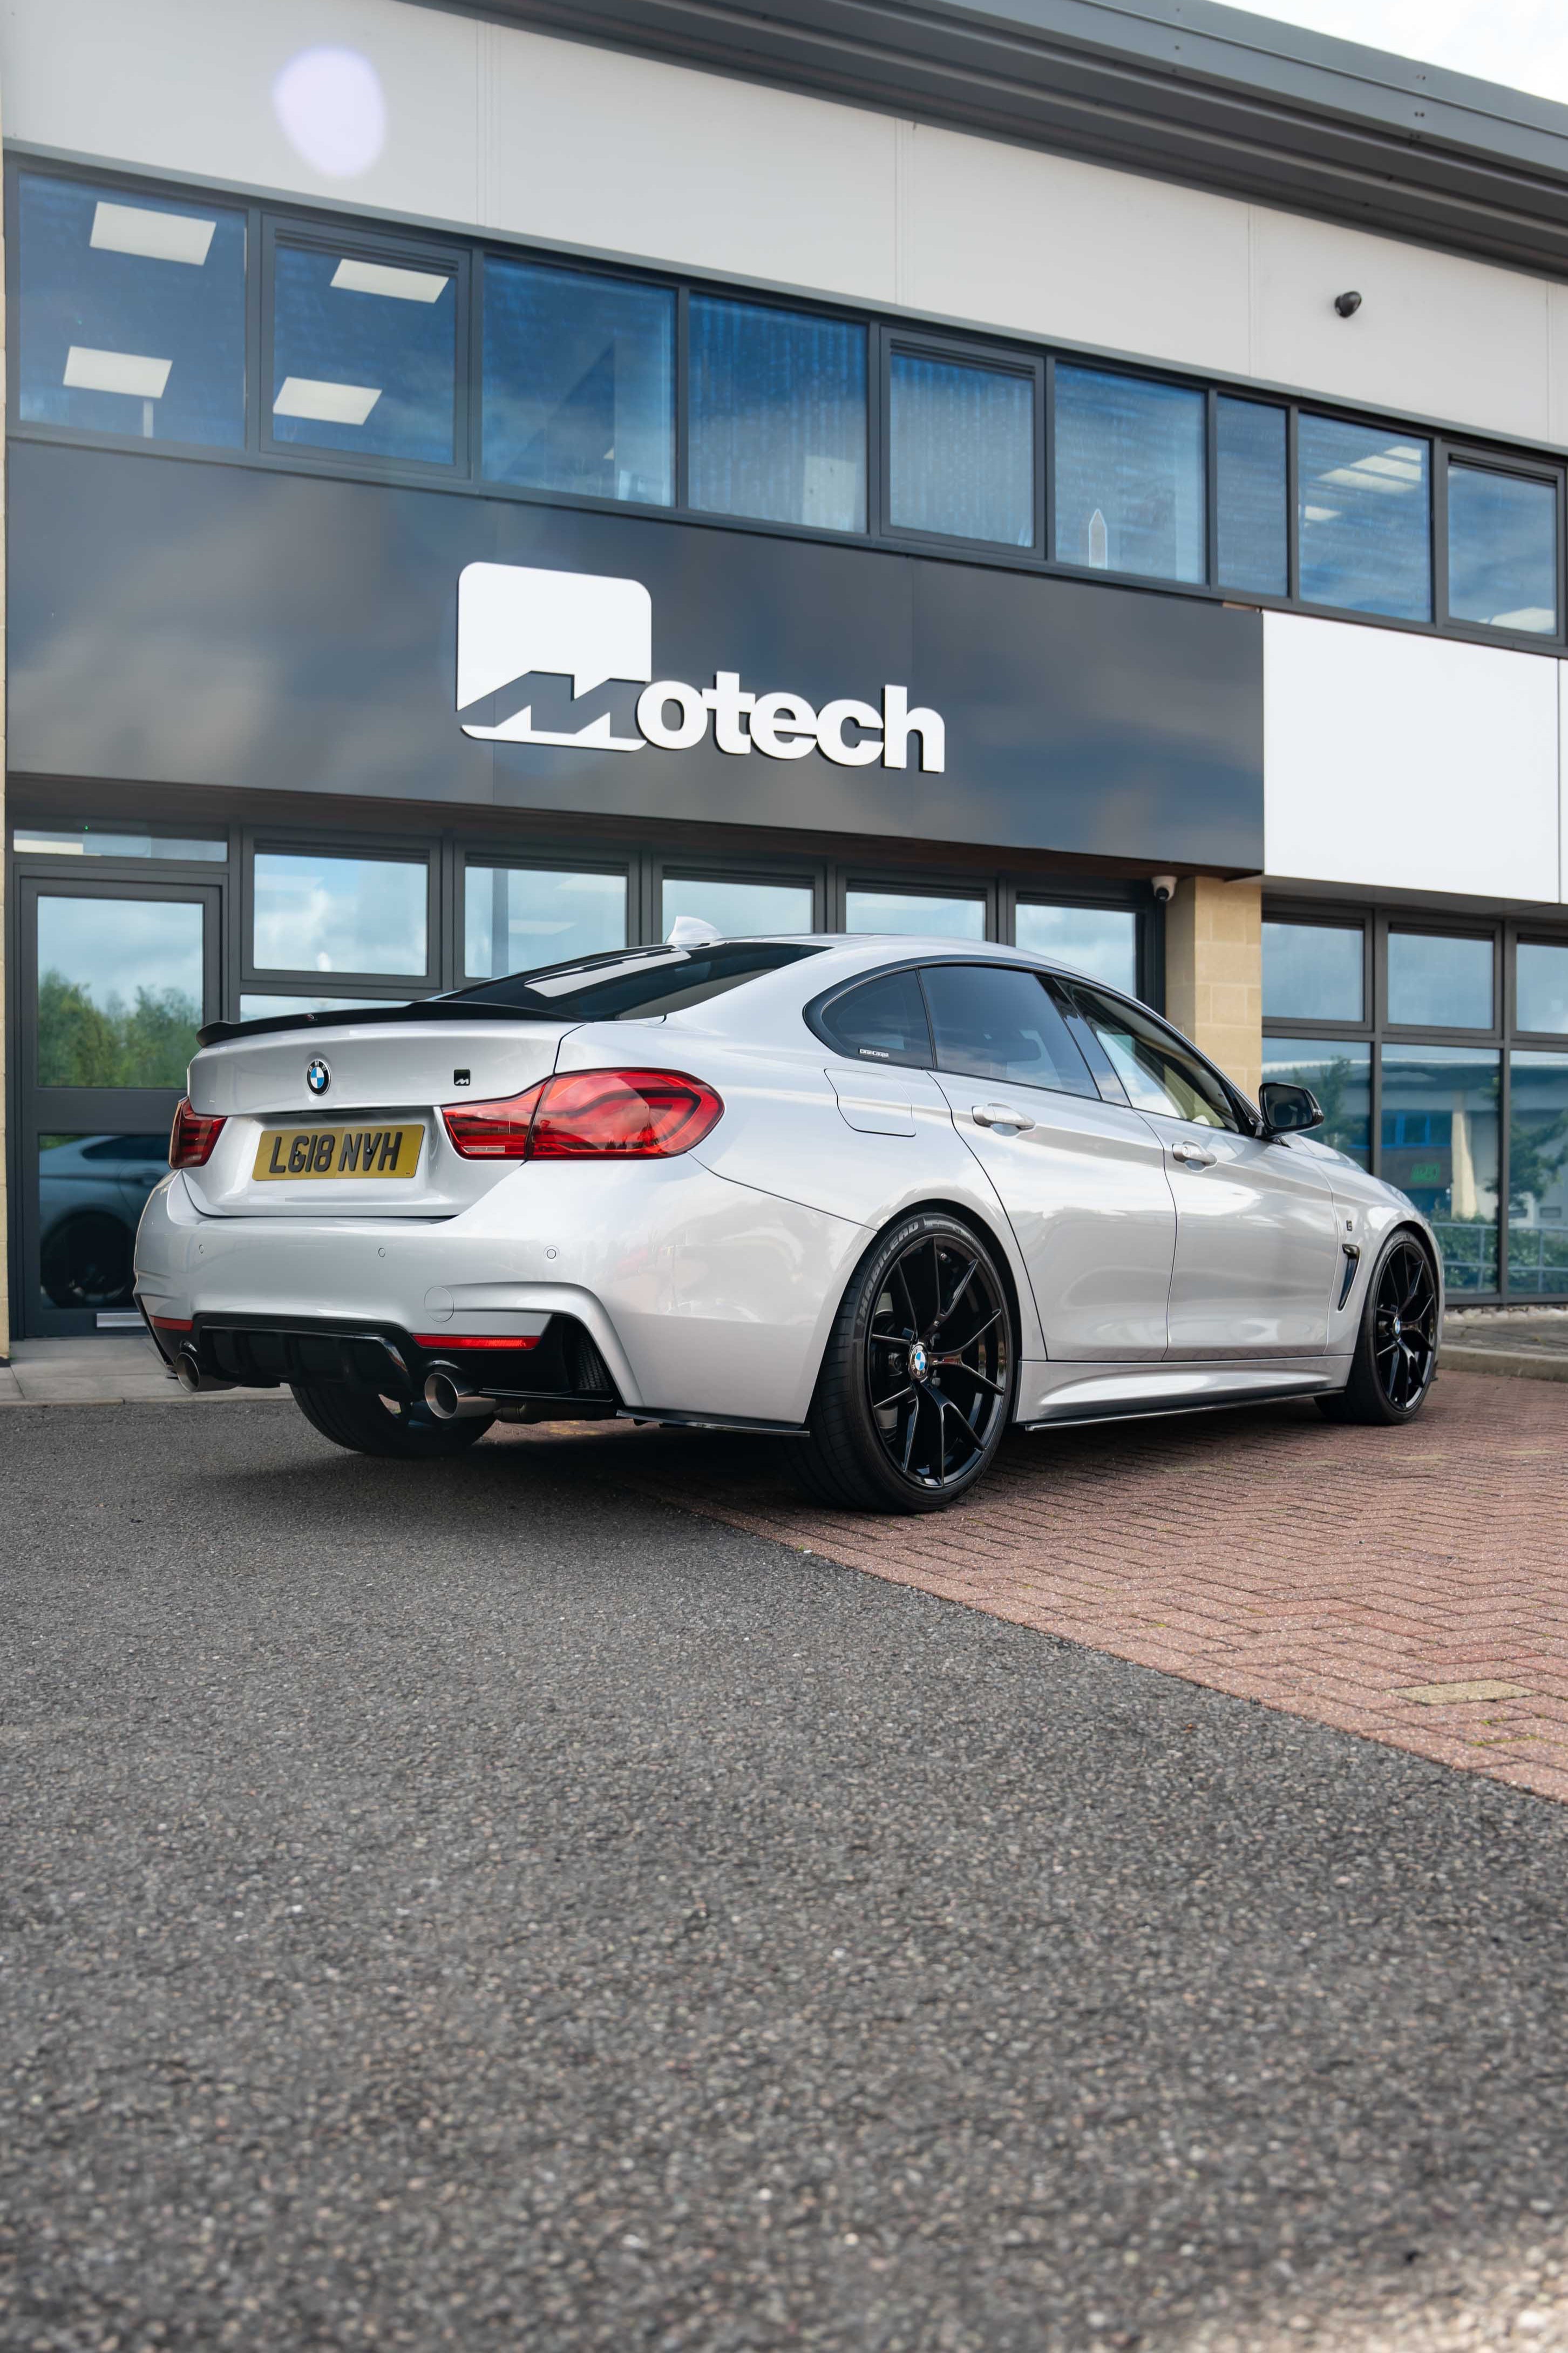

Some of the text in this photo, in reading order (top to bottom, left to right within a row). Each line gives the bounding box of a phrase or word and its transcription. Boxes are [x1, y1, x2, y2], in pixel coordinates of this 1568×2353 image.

[269, 1132, 403, 1173] LG18 NVH
[859, 1221, 919, 1319] HABILEAD
